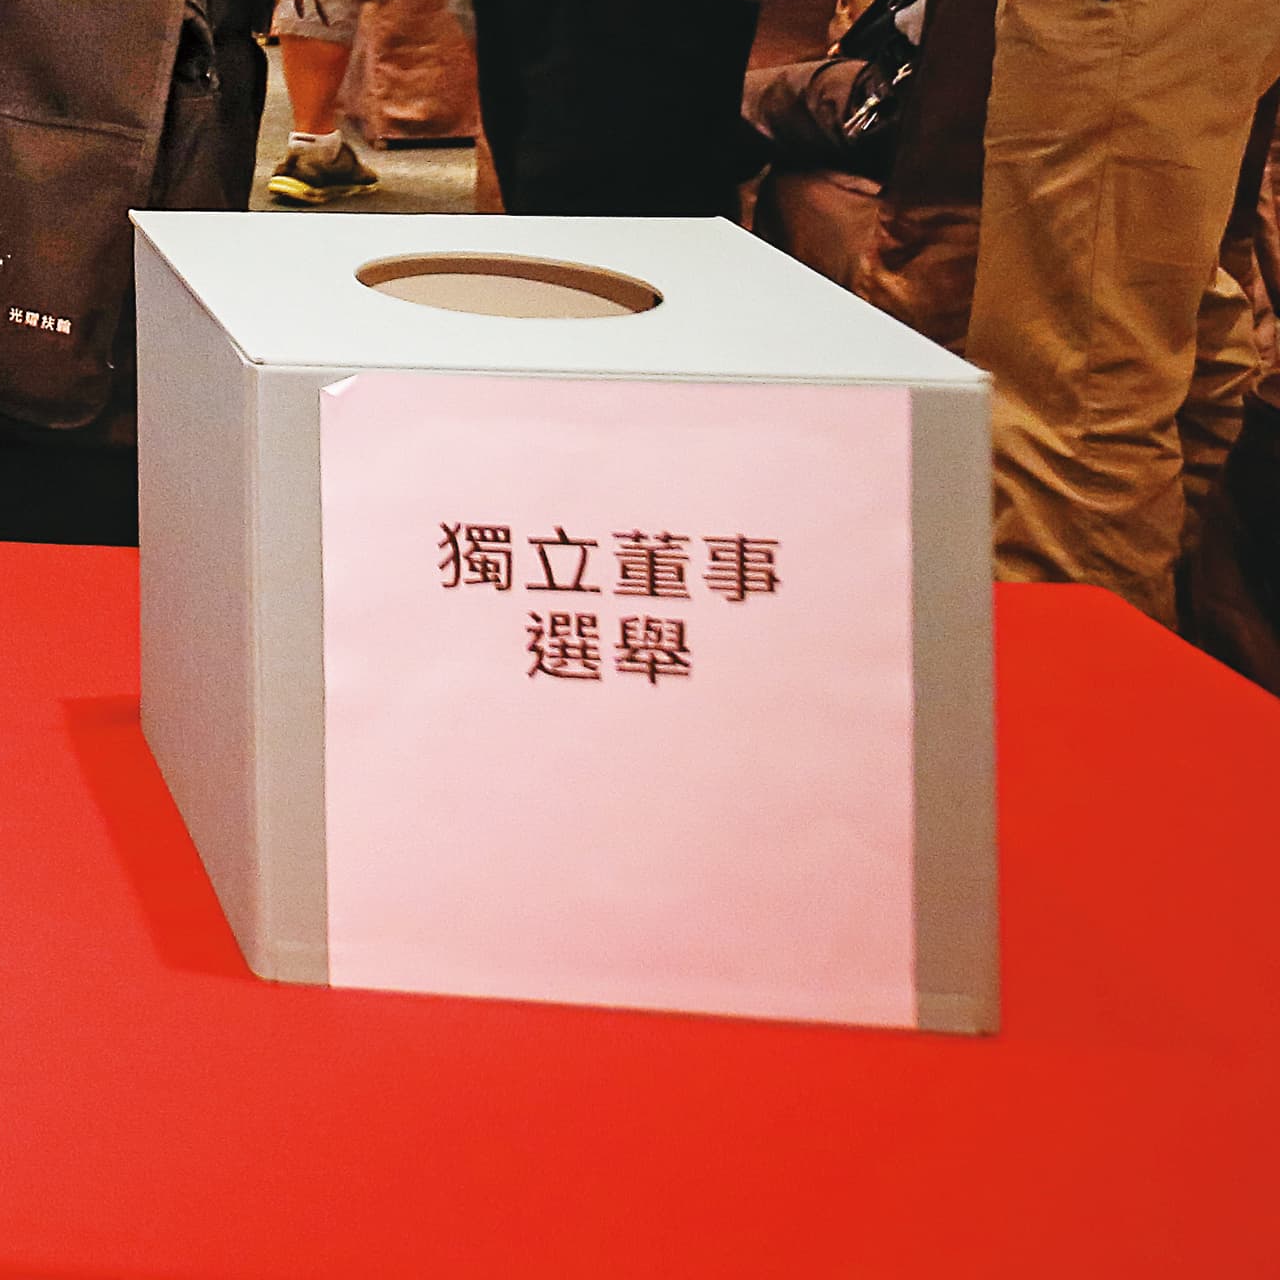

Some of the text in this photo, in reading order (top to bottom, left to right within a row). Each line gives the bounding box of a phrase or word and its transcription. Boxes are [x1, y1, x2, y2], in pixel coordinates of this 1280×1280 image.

[437, 521, 782, 603] 獨立董事
[526, 610, 692, 686] 選舉
